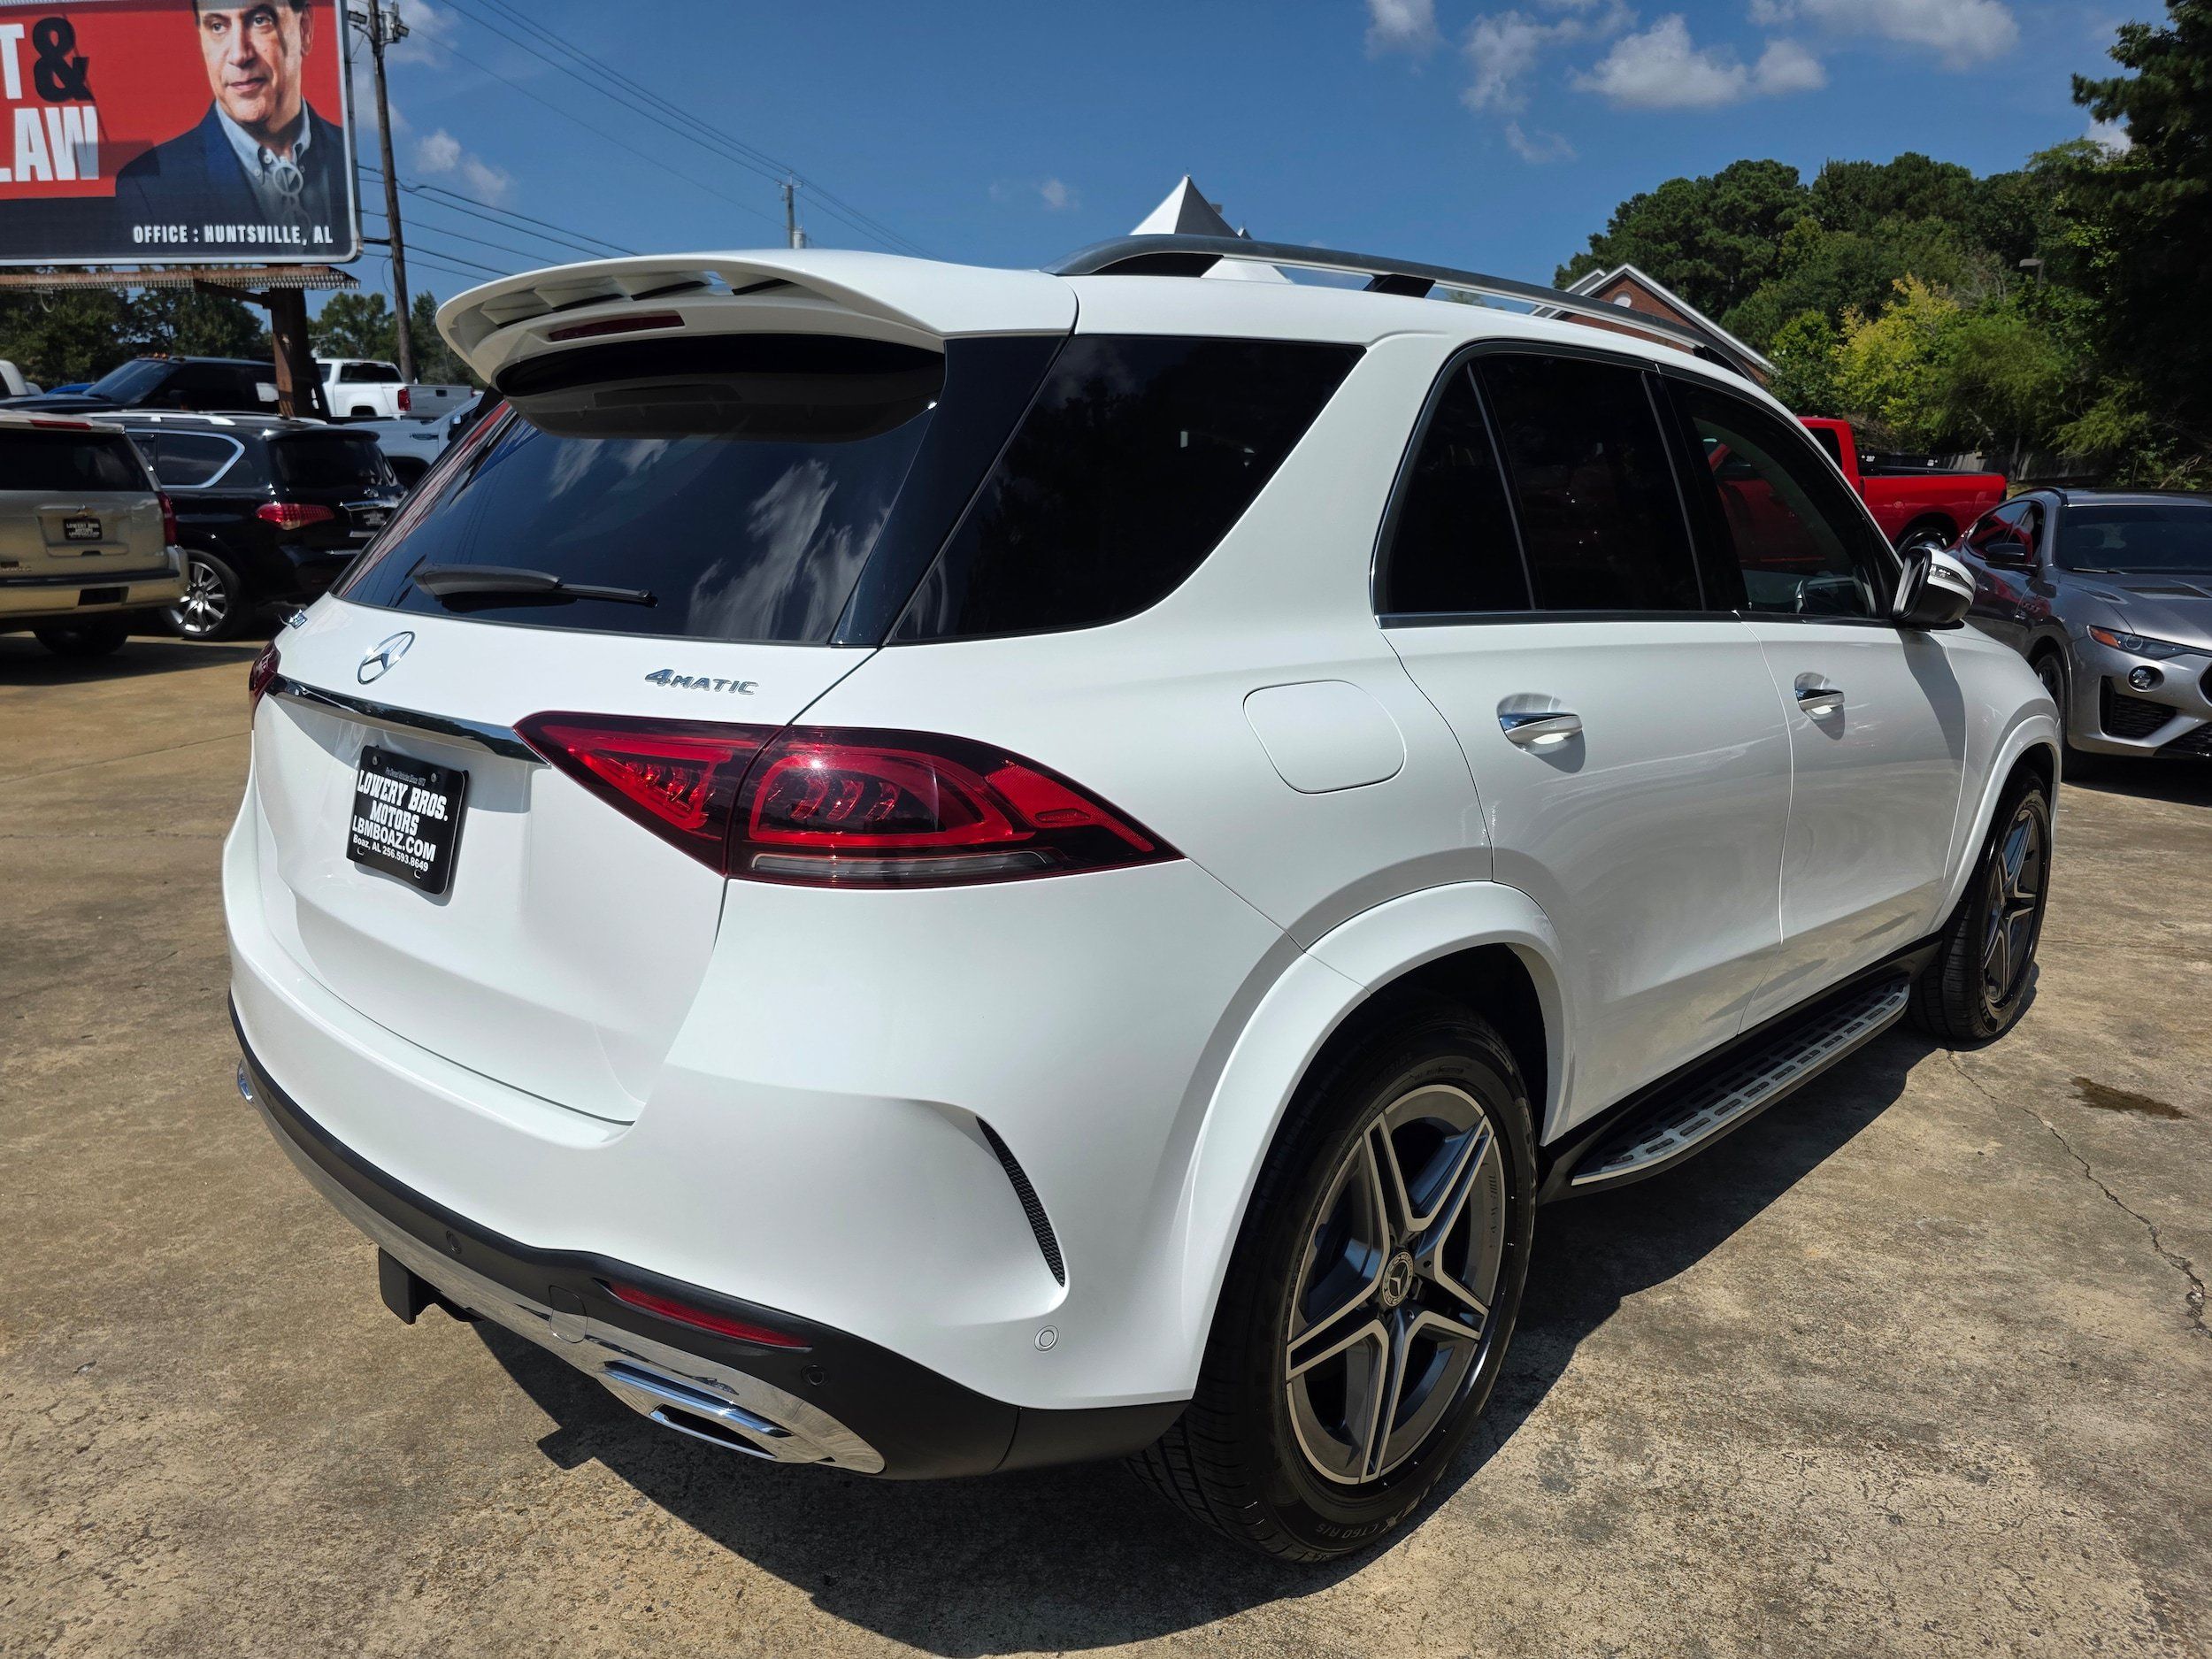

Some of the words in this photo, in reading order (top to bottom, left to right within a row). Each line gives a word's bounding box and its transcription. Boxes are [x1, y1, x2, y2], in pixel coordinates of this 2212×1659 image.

[33, 17, 96, 103] &
[133, 225, 188, 244] OFFICE
[204, 225, 308, 246] HUNTSVILLE,
[313, 225, 334, 244] AL
[644, 668, 759, 695] 4MATIC
[357, 769, 409, 806] LOWERY
[407, 787, 449, 821] BROS.
[369, 799, 420, 836] MOTORS
[352, 814, 437, 862] LBMBOAZ.COM
[352, 833, 371, 850] Boaz,
[372, 841, 382, 853] AL
[382, 845, 429, 872] 256.593.8649
